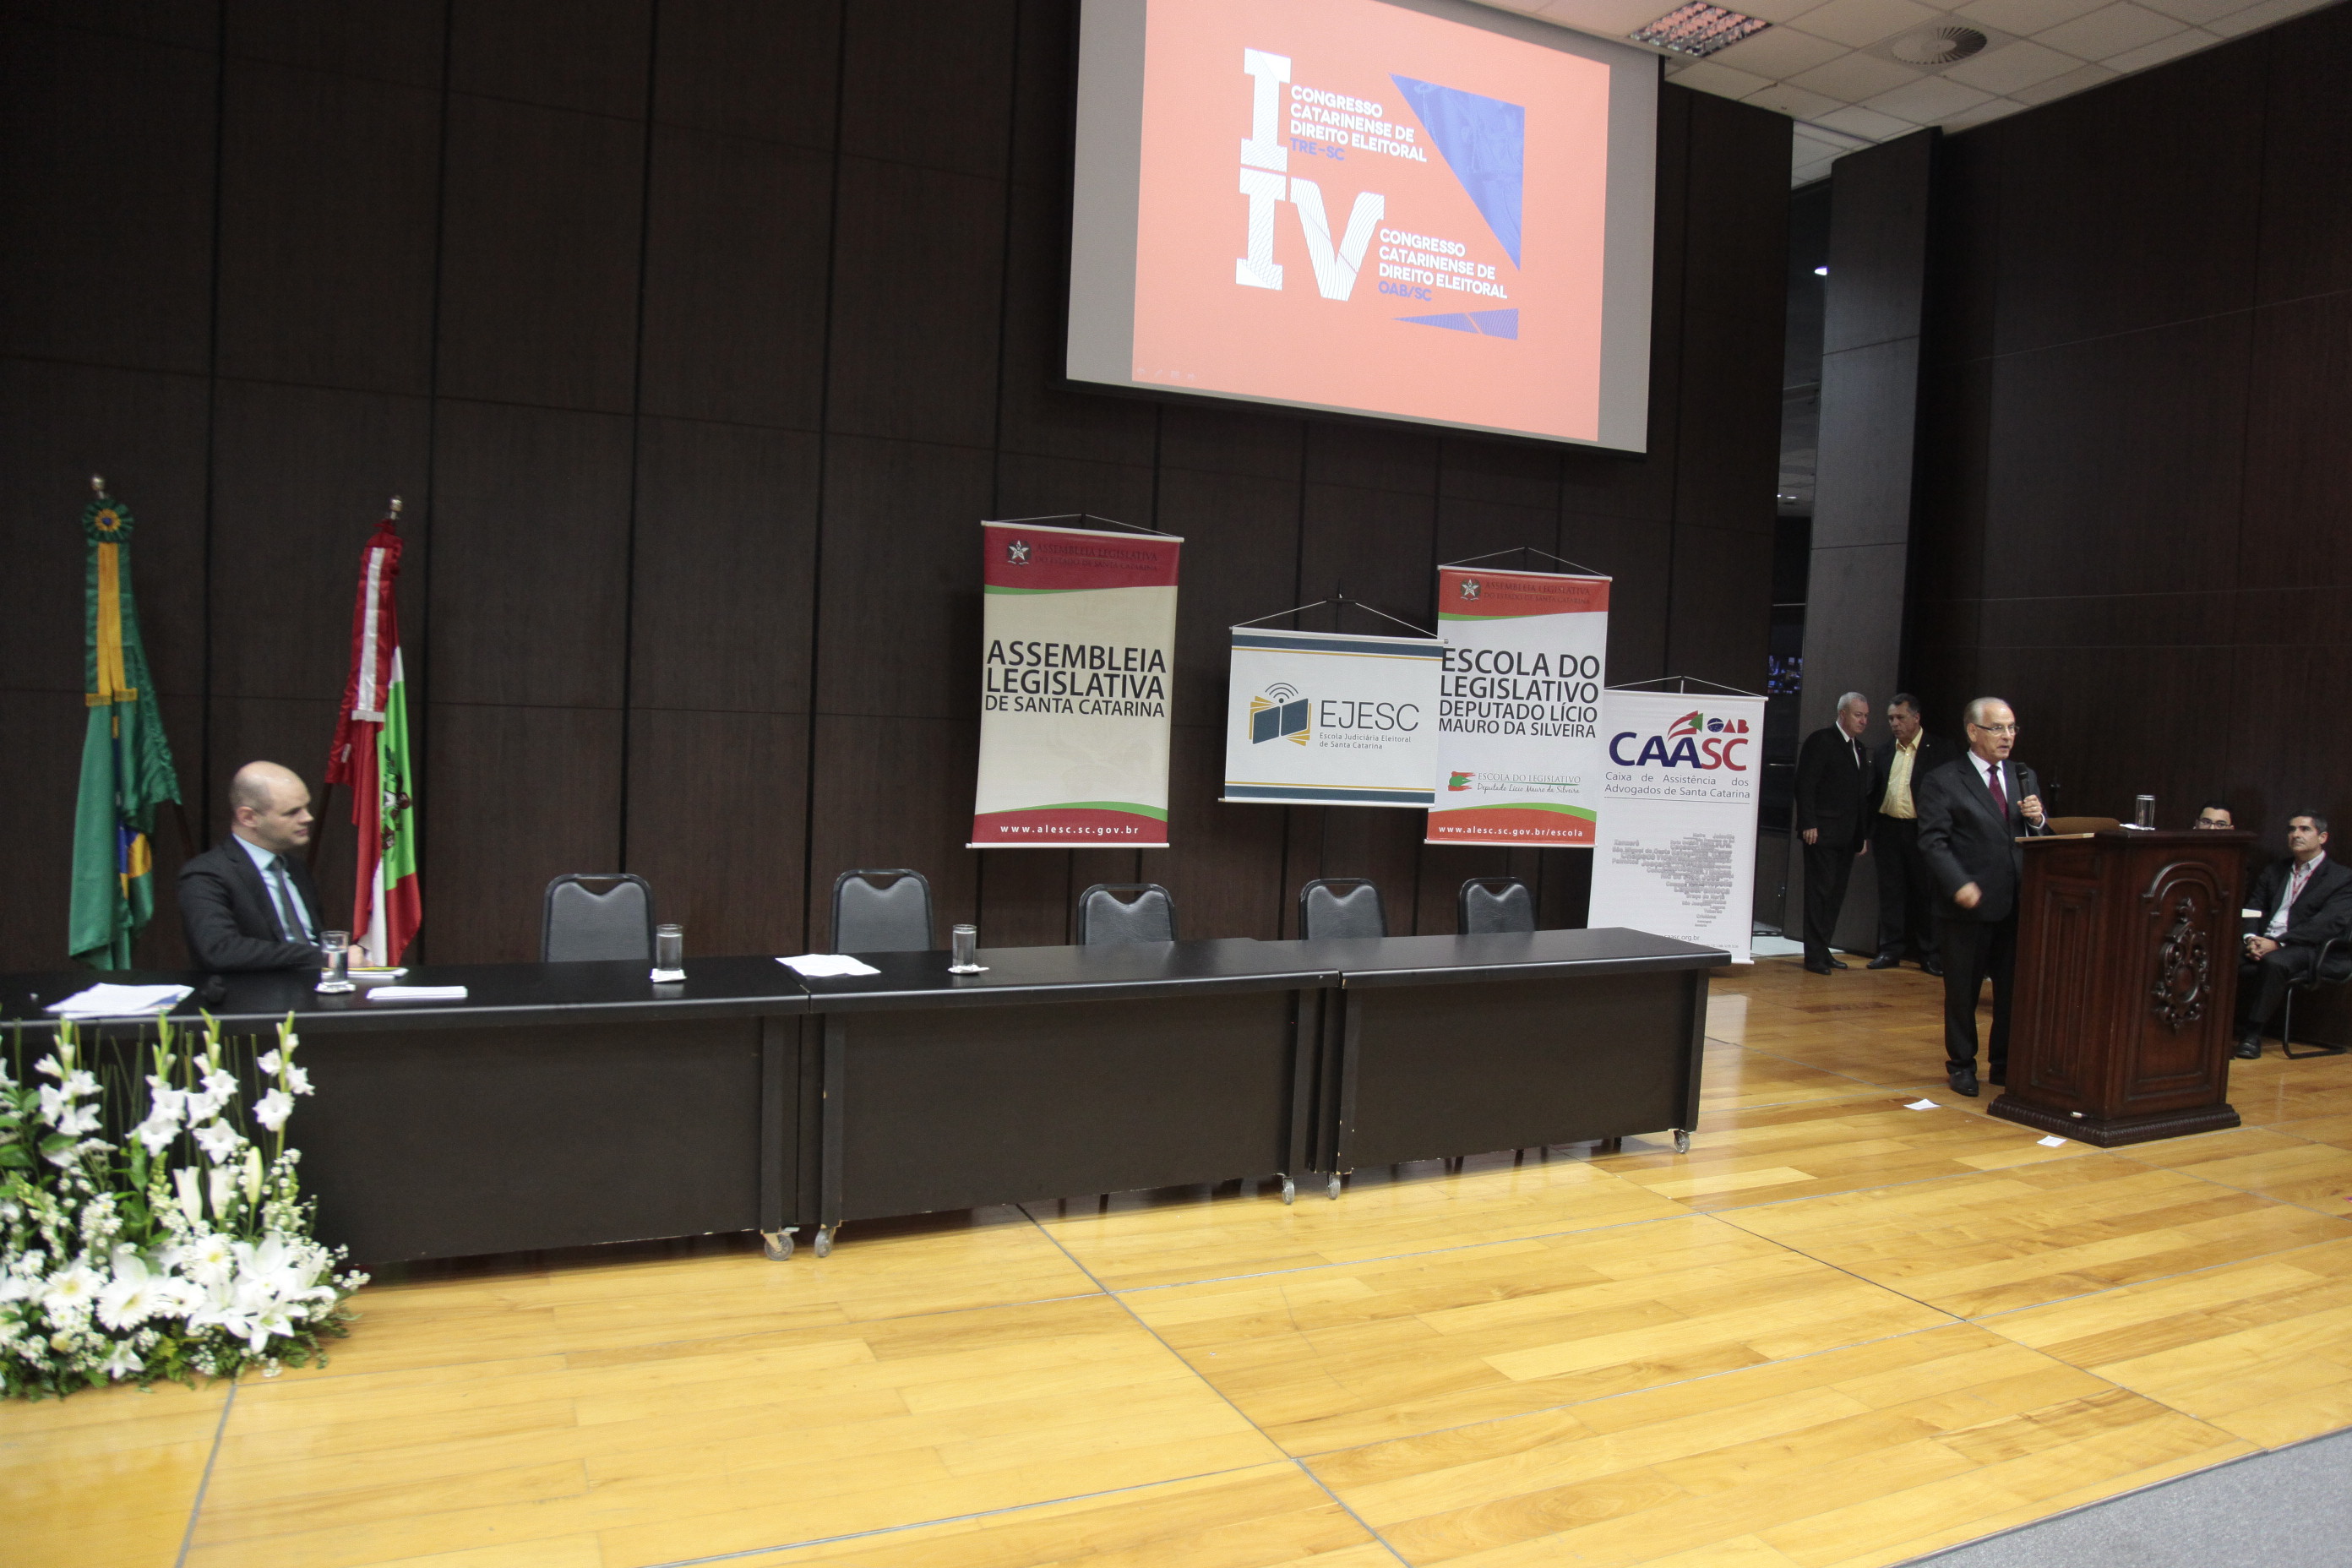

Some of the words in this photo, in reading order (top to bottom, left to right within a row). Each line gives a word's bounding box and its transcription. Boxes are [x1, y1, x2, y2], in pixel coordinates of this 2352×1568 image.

[1290, 84, 1383, 118] CONGRESSO
[1289, 103, 1392, 138] CATARINENSE
[1395, 125, 1415, 143] DE
[1289, 137, 1346, 161] TRE-SC
[1290, 119, 1349, 145] DIREITO
[1351, 133, 1428, 162] ELEITORAL
[1235, 167, 1385, 301] IV
[1380, 228, 1466, 258] CONGRESSO
[1379, 246, 1475, 276] CATARINENSE
[1477, 264, 1496, 280] DE
[1378, 280, 1432, 302] OAB/SC
[1379, 263, 1435, 286] DIREITO
[1436, 273, 1508, 299] ELEITORAL
[1036, 543, 1096, 558] ASSEMBLEIA
[1097, 547, 1158, 562] LEGISLATIVA
[1485, 581, 1536, 592] ASSEMBLEIA
[1538, 585, 1590, 596] LEGISLATIVA
[986, 640, 1167, 673] ASSEMBLEIA
[1441, 648, 1550, 677] ESCOLA
[1560, 654, 1600, 679] DO
[986, 667, 1166, 700] LEGISLATIVA
[1440, 675, 1599, 704] LEGISLATIVO
[985, 694, 1009, 711] DE
[1014, 696, 1074, 714] SANTA
[1079, 700, 1165, 717] CATARINA
[1320, 700, 1420, 732] EJESC
[1440, 700, 1545, 721] DEPUTADO
[1550, 702, 1598, 723] LÍCIO
[1438, 717, 1500, 734] MAURO
[1504, 720, 1526, 735] DA
[1530, 721, 1596, 738] SILVEIRA
[1707, 717, 1750, 733] OAB
[1344, 732, 1380, 742] Judiciária
[1381, 734, 1412, 743] Eleitoral
[1353, 742, 1383, 750] Catarina
[1609, 732, 1749, 771] CAASC
[1477, 782, 1507, 794] Deputado
[1478, 772, 1511, 781] ESCOLA
[1528, 774, 1581, 783] LEGISLATIVO
[1605, 772, 1632, 781] Caixa
[1641, 773, 1654, 781] de
[1663, 774, 1716, 785] Assistência
[1731, 778, 1749, 787] dos
[1604, 784, 1661, 795] Advogados
[1664, 787, 1677, 795] de
[1680, 787, 1707, 797] Santa
[1709, 789, 1750, 798] Catarina
[1000, 824, 1140, 836] www.alesc.sc.gov.br
[1438, 825, 1583, 837] www.alesc.sc.gov.br/escola
